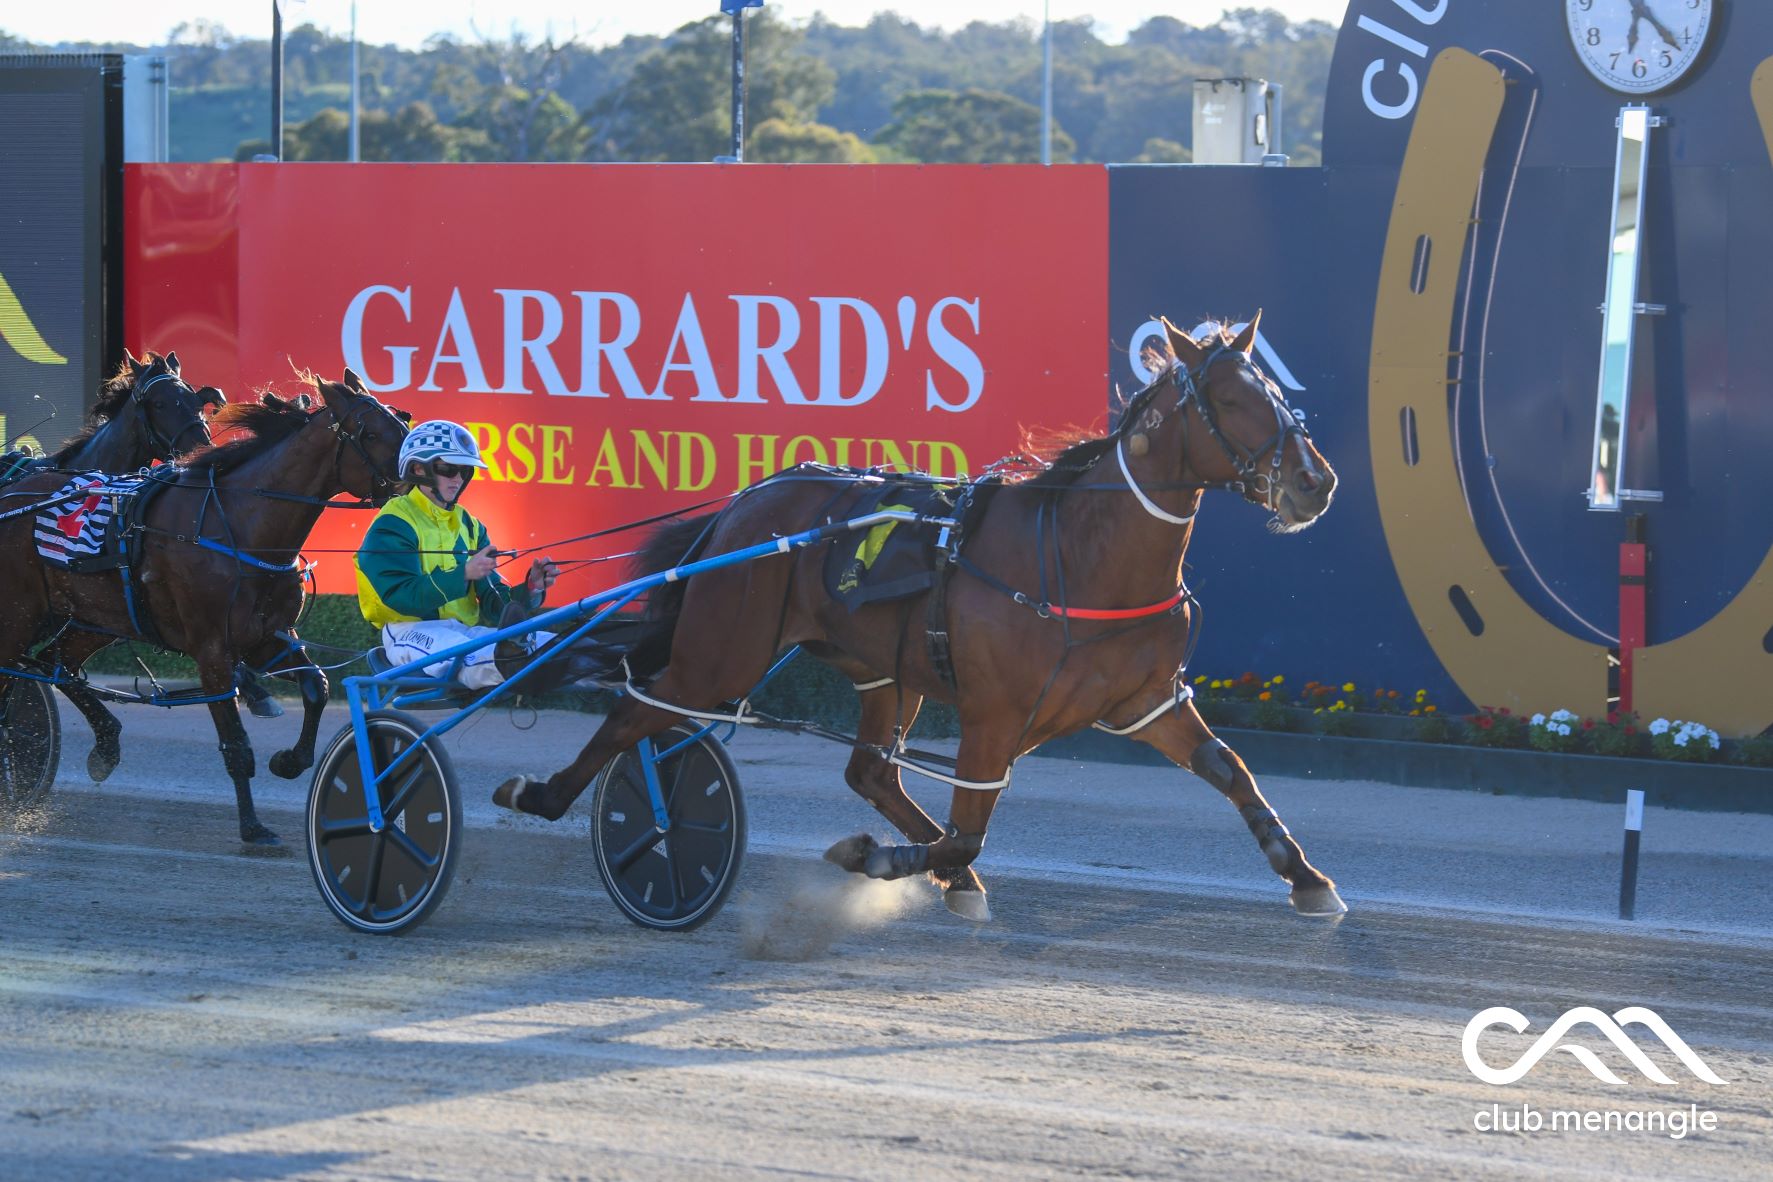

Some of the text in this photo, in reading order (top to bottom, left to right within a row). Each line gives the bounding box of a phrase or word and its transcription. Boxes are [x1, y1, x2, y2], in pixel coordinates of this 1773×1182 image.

[1587, 27, 1601, 46] 8
[1678, 25, 1693, 45] 4
[1608, 52, 1621, 71] 7
[1631, 59, 1648, 79] 6
[1659, 50, 1673, 68] 5
[340, 284, 986, 414] GARRARD'S
[409, 420, 575, 485] RSE
[585, 427, 717, 492] AND
